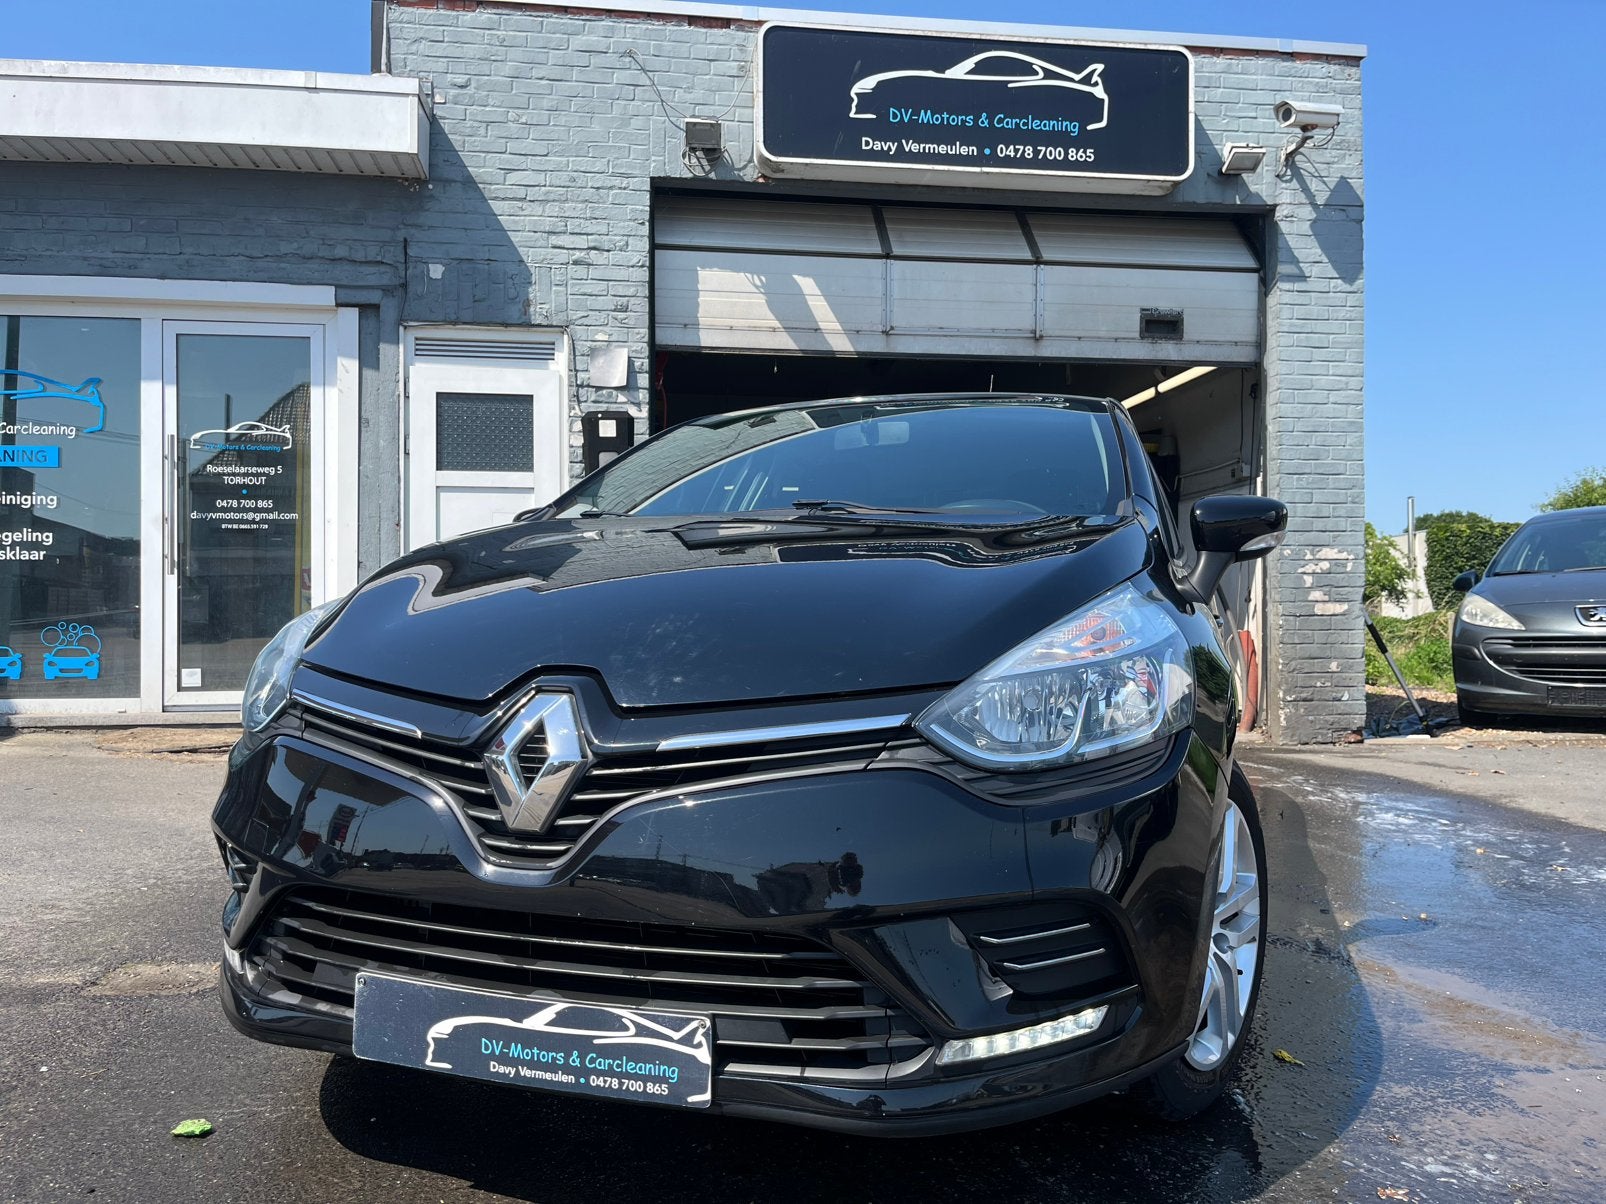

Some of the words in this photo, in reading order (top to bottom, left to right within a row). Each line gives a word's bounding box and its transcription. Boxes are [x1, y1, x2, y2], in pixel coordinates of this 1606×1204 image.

[888, 108, 974, 127] DV-Motors
[979, 112, 990, 128] &
[994, 113, 1080, 136] Carcleaning
[861, 137, 897, 153] Davy
[901, 139, 978, 156] Vermeulen
[996, 144, 1033, 159] 0478
[1037, 146, 1064, 160] 700
[1068, 148, 1095, 162] 865
[0, 449, 48, 463] NING
[207, 464, 275, 476] Roeselaarseweg
[277, 465, 283, 474] 5
[223, 476, 267, 485] TORHOUT
[216, 499, 237, 508] 0478
[239, 499, 256, 508] 700
[257, 500, 273, 508] 865
[190, 511, 299, 522] davyvmotors@gmail.com
[481, 1038, 565, 1065] DV-Motors
[569, 1051, 581, 1066] &
[585, 1053, 679, 1082] Carcleaning
[490, 1061, 516, 1077] Davy
[518, 1065, 575, 1083] Vermeulen
[589, 1076, 619, 1090] 0478
[621, 1079, 643, 1092] 700
[646, 1082, 669, 1095] 865
